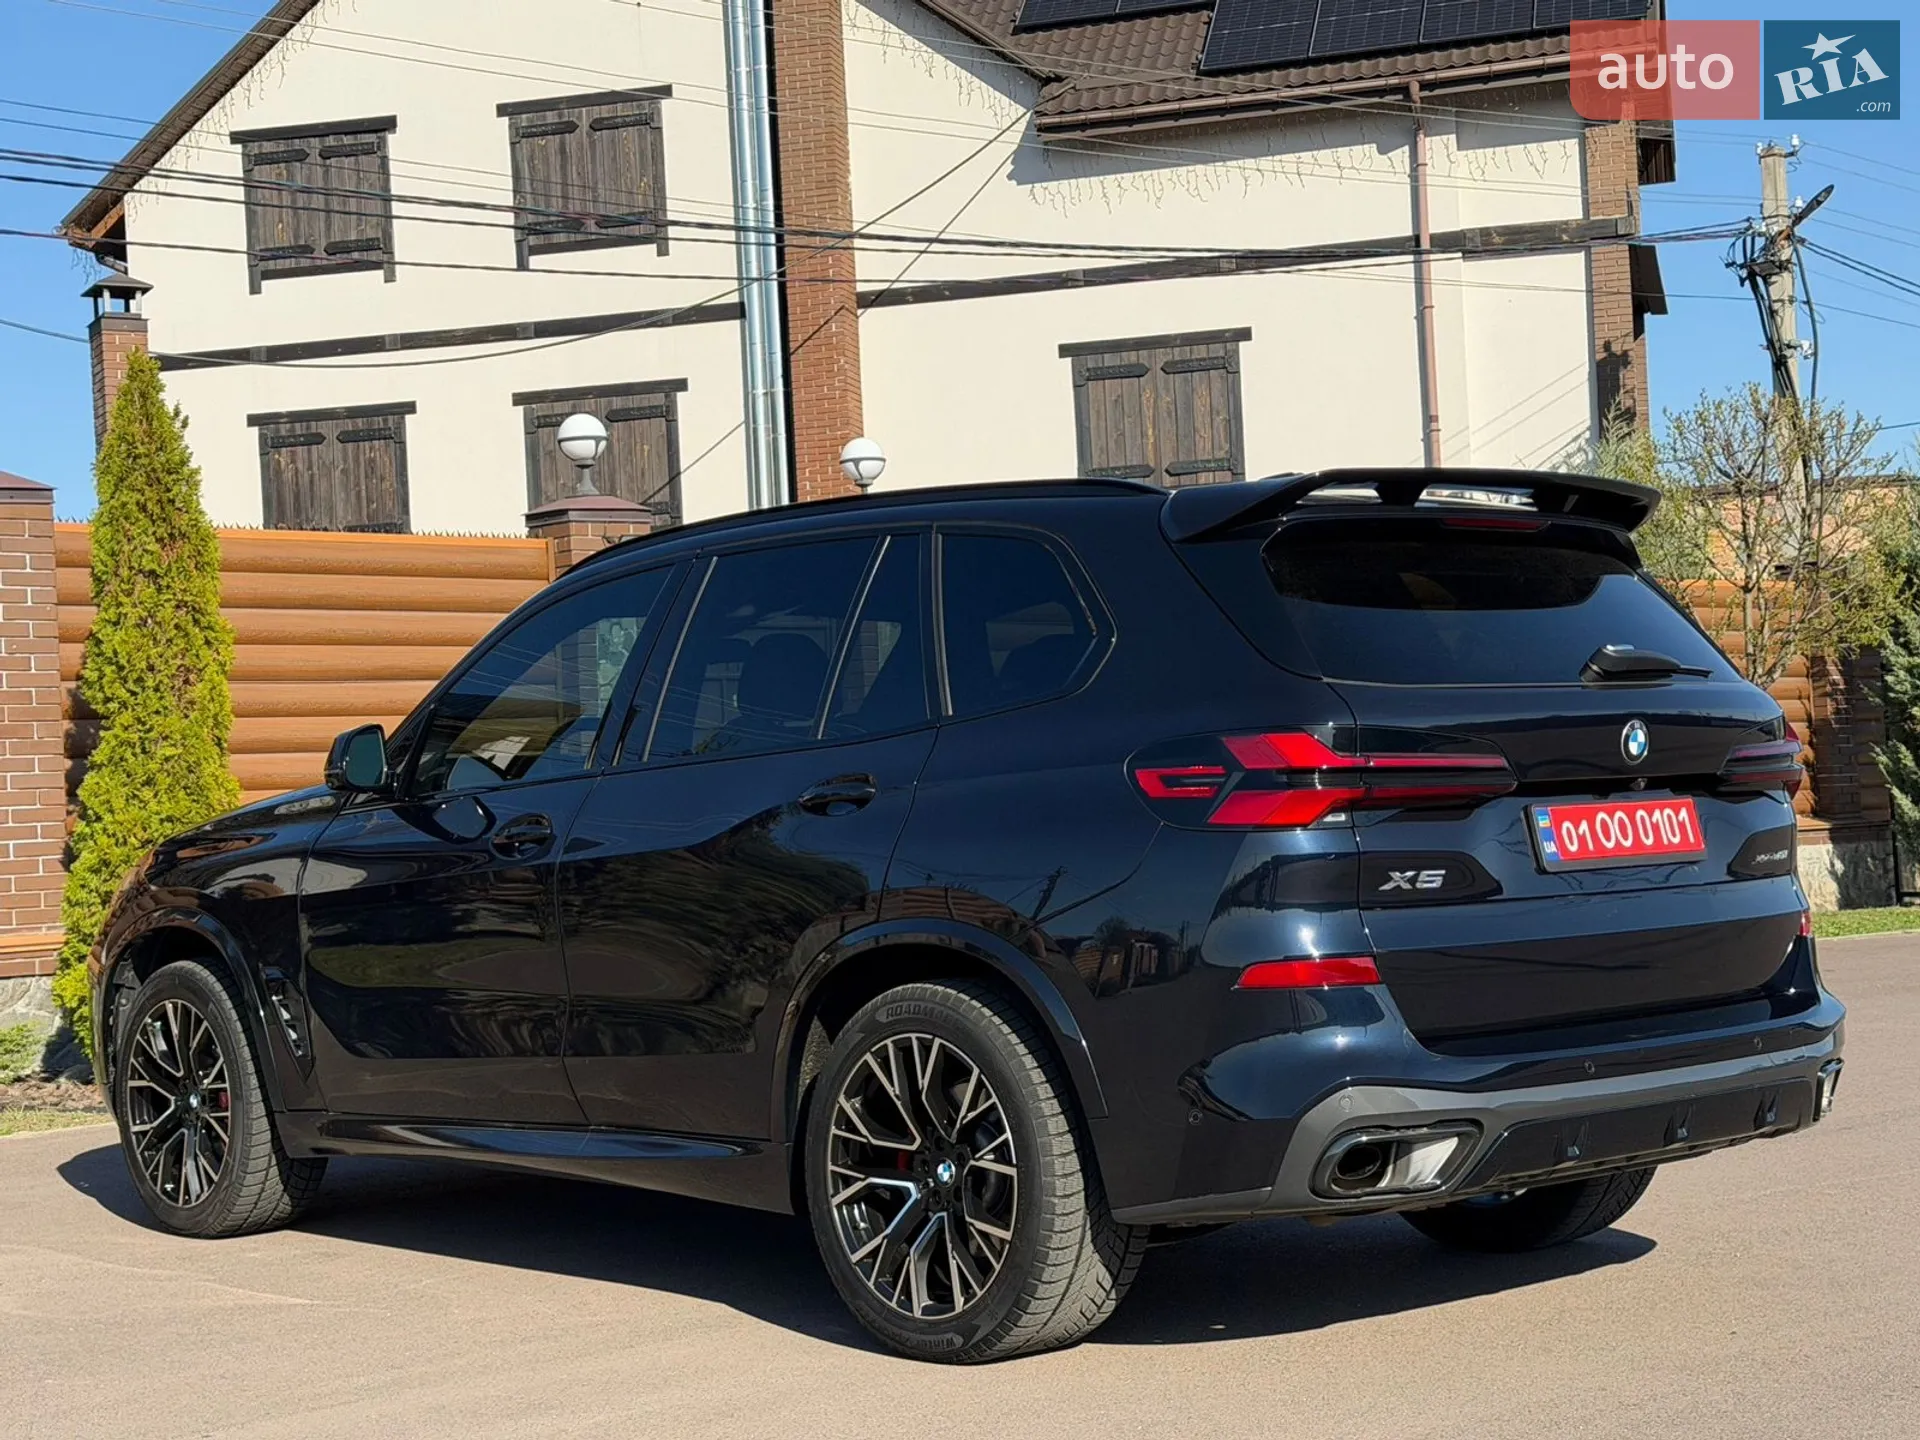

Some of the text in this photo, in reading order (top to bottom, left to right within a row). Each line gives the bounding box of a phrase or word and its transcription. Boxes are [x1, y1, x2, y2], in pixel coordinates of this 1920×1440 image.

[1561, 819, 1594, 852] 01
[1635, 807, 1695, 846] 0101
[1543, 841, 1558, 853] UA
[1378, 869, 1446, 891] X5
